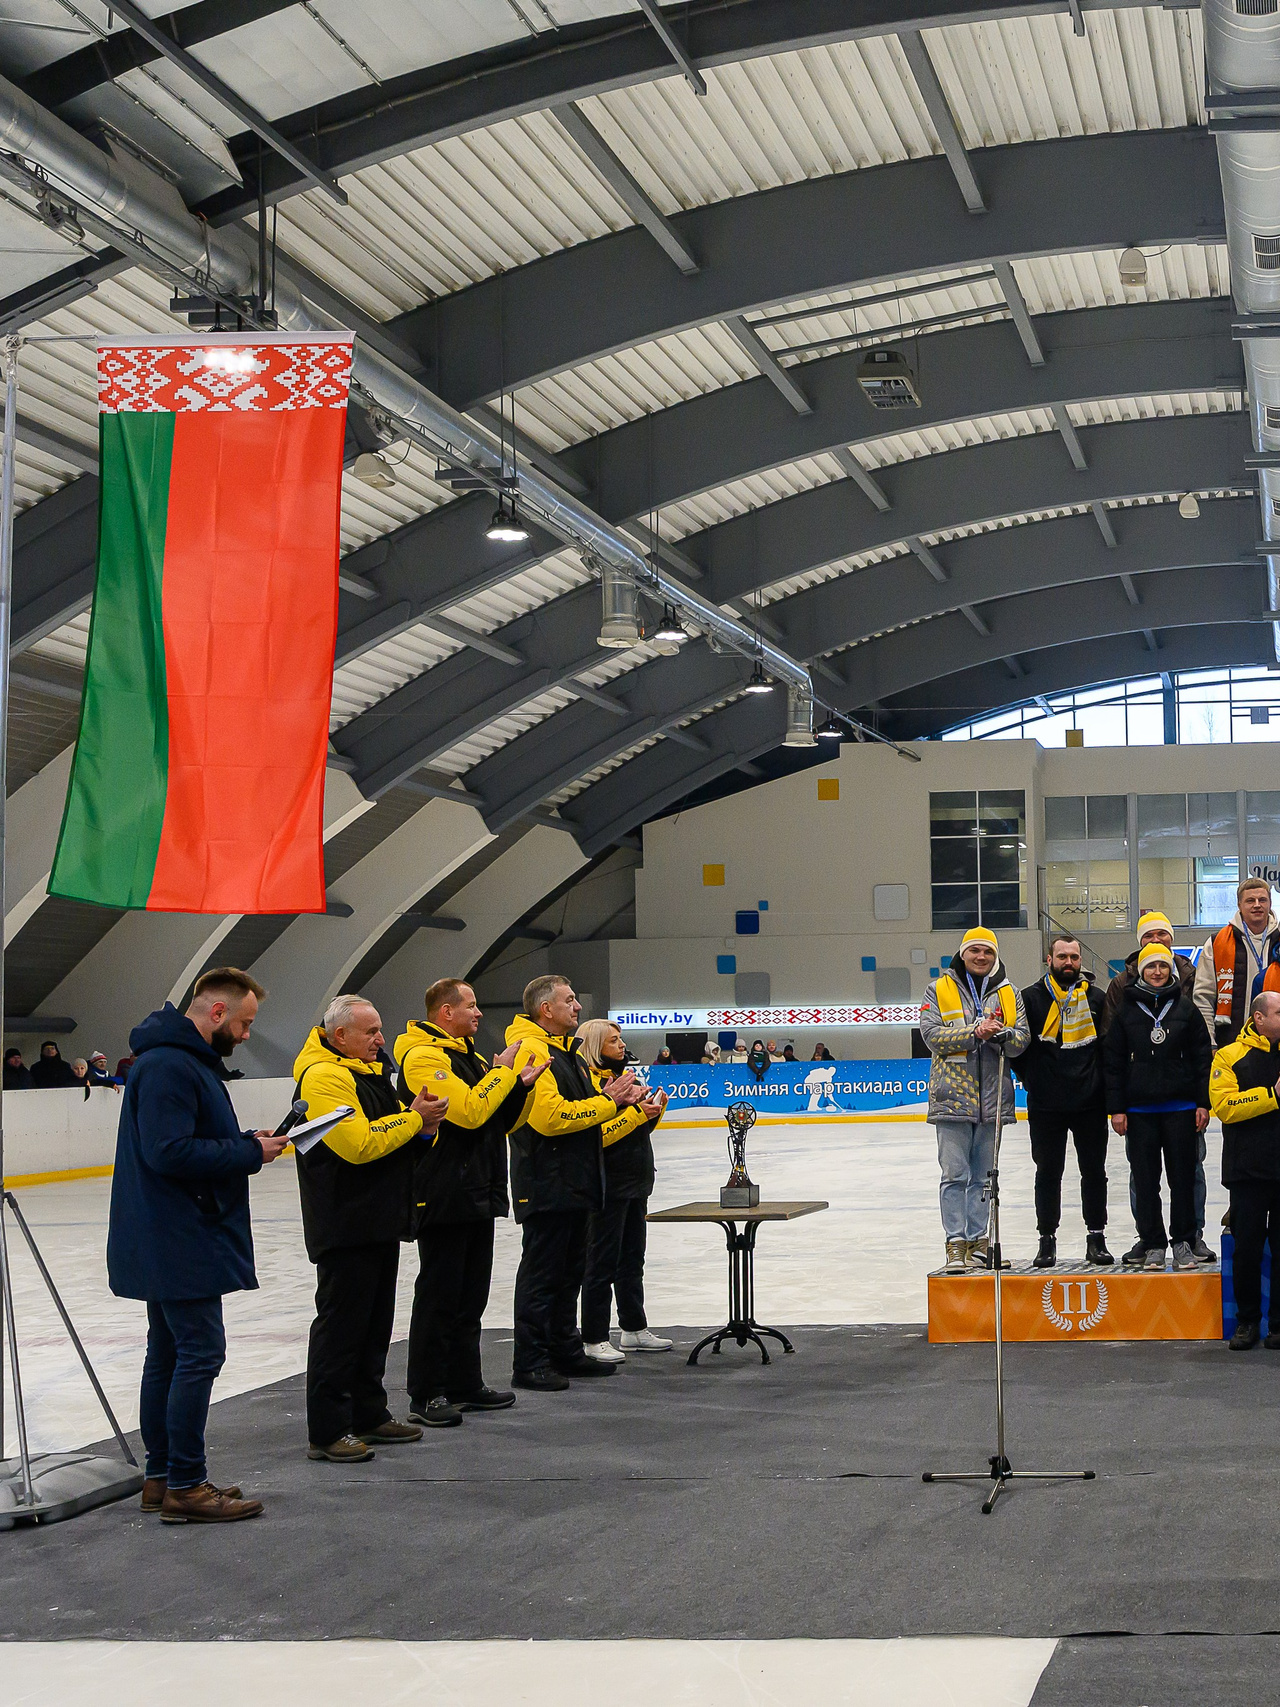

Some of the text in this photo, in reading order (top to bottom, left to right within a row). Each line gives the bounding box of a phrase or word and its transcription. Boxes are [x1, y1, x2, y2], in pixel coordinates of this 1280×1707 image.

[617, 1012, 693, 1026] silichy.by
[668, 1079, 930, 1099] 2026 Зимняя спартакиада ср
[560, 1109, 597, 1120] BELARUS
[1058, 1282, 1092, 1314] II
